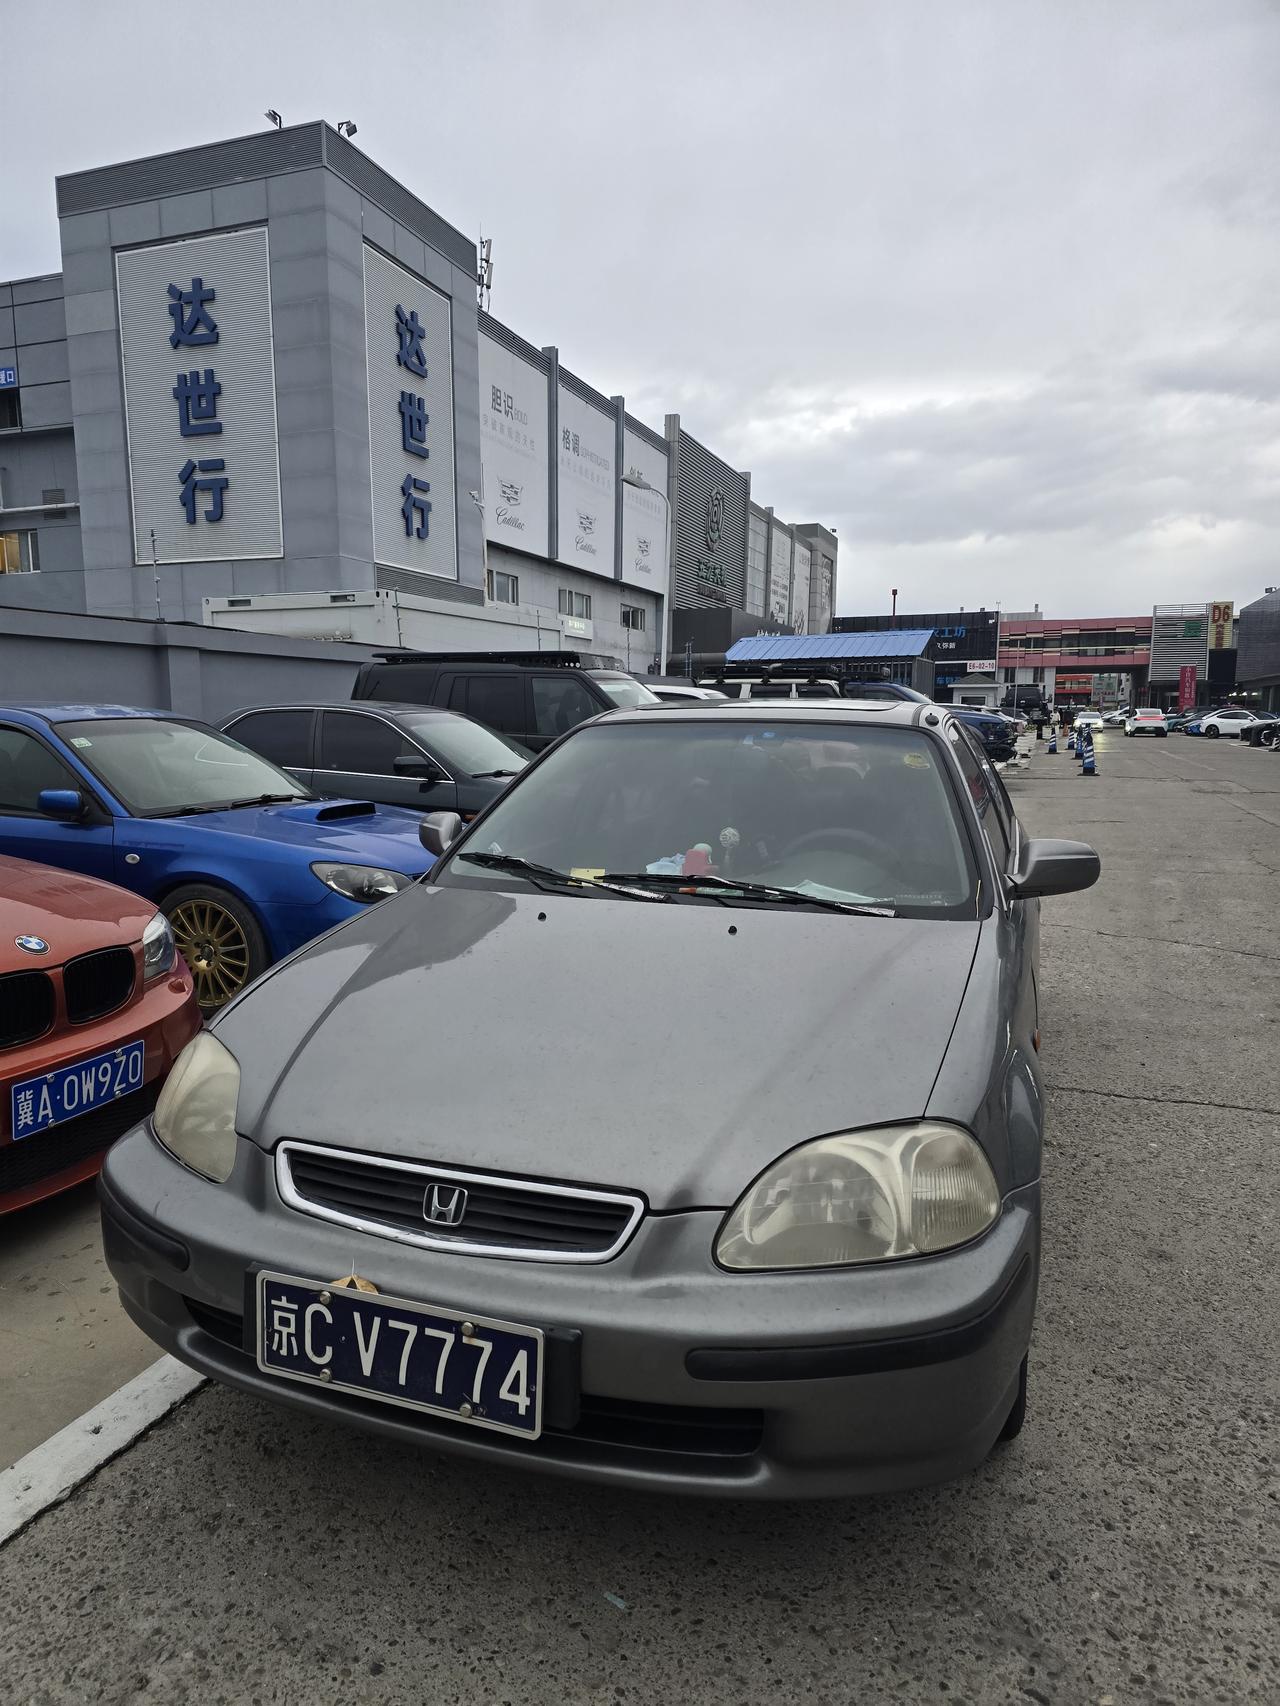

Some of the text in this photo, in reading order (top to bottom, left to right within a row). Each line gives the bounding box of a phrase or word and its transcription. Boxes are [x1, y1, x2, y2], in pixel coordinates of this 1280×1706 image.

[167, 277, 228, 524] 达世行
[491, 384, 514, 421] 胆识
[395, 303, 432, 540] 达世行
[496, 506, 526, 531] Cadillac
[574, 535, 598, 556] Cadillac
[1212, 605, 1231, 624] D6
